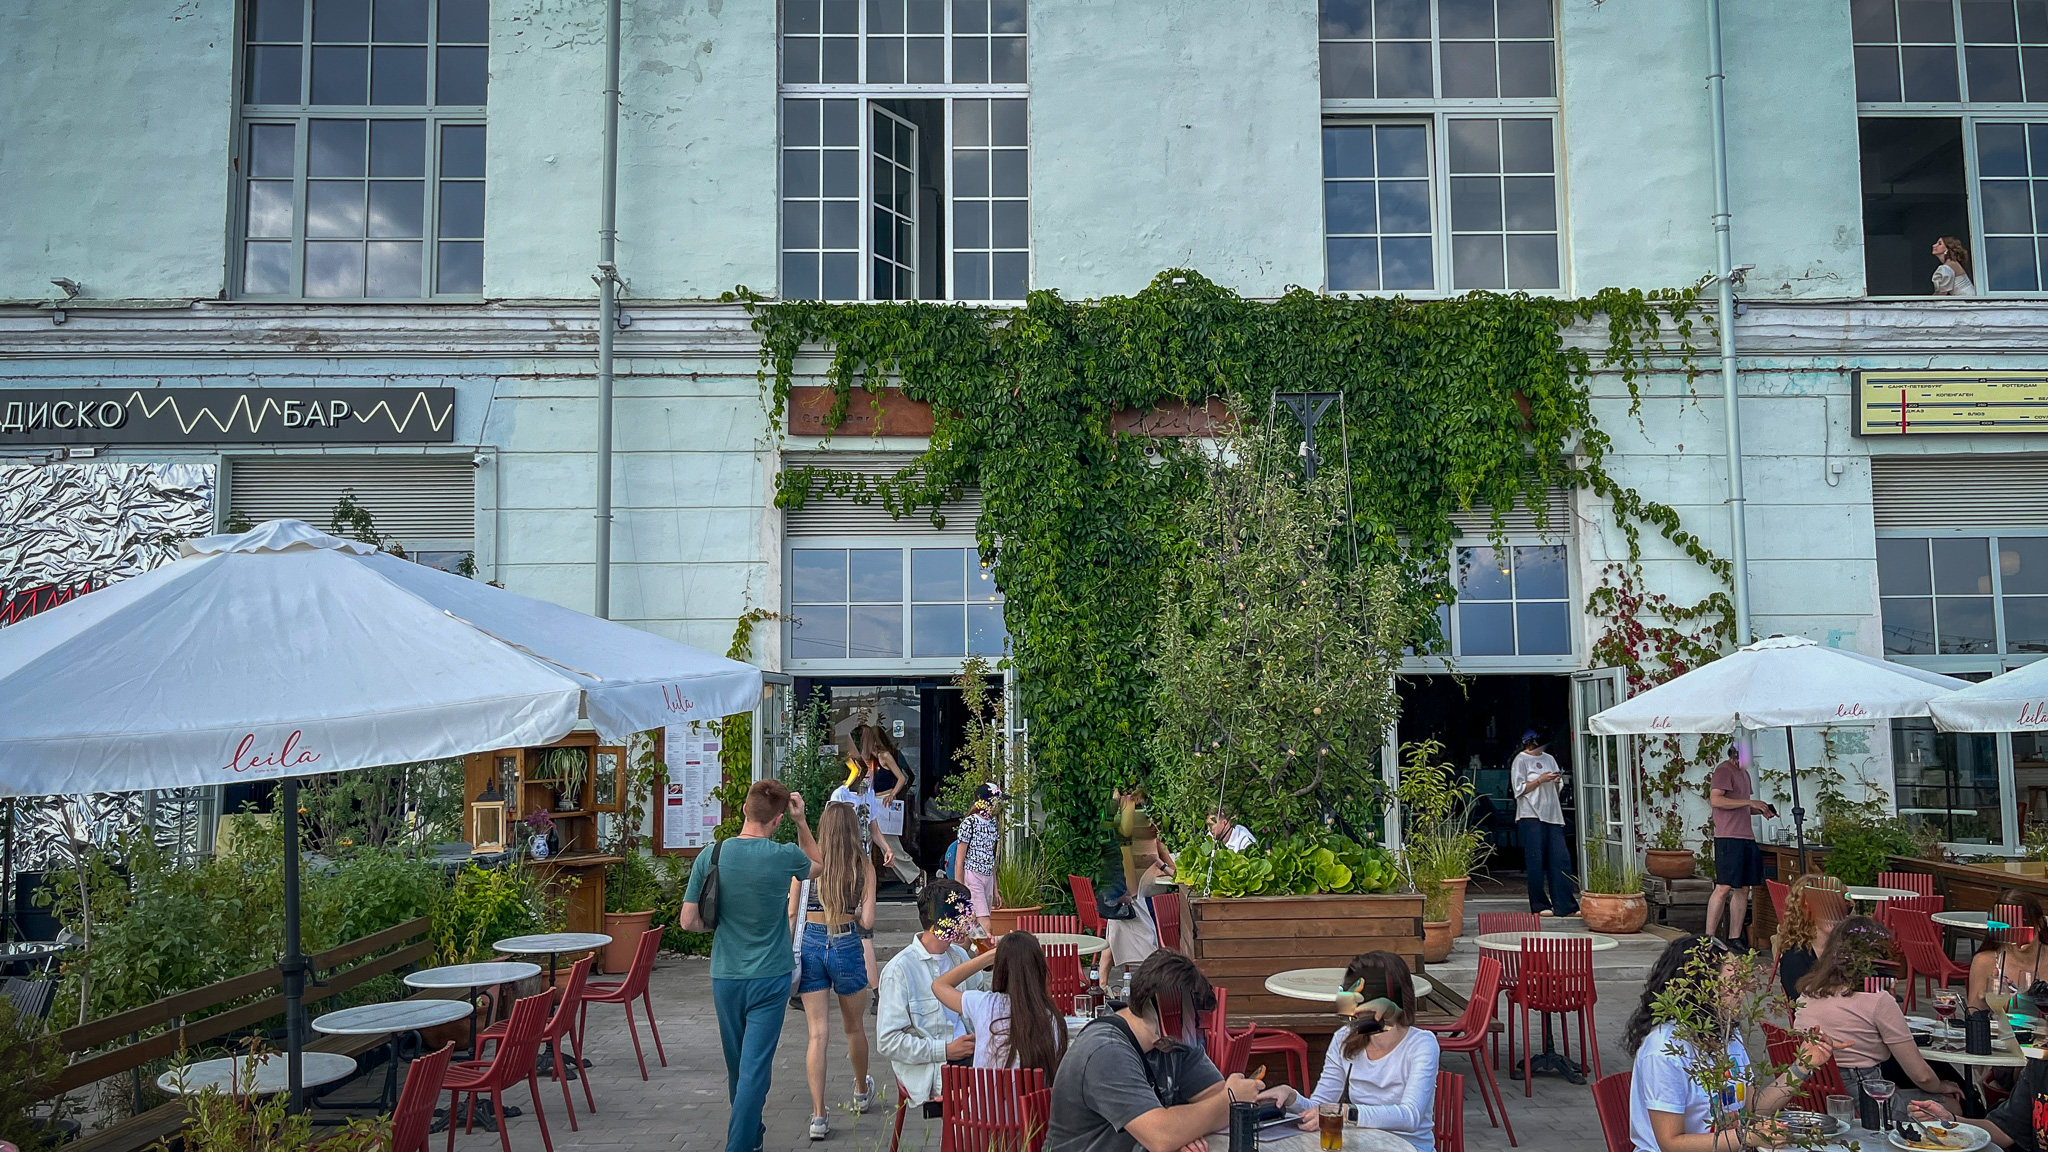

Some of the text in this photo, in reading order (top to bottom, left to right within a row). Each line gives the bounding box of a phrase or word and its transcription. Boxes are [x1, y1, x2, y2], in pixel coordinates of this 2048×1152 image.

[1, 400, 352, 433] ДИСКО БАР
[662, 684, 694, 713] leila
[1835, 703, 1867, 718] leila
[1650, 716, 1672, 730] leila
[222, 729, 321, 772] leila
